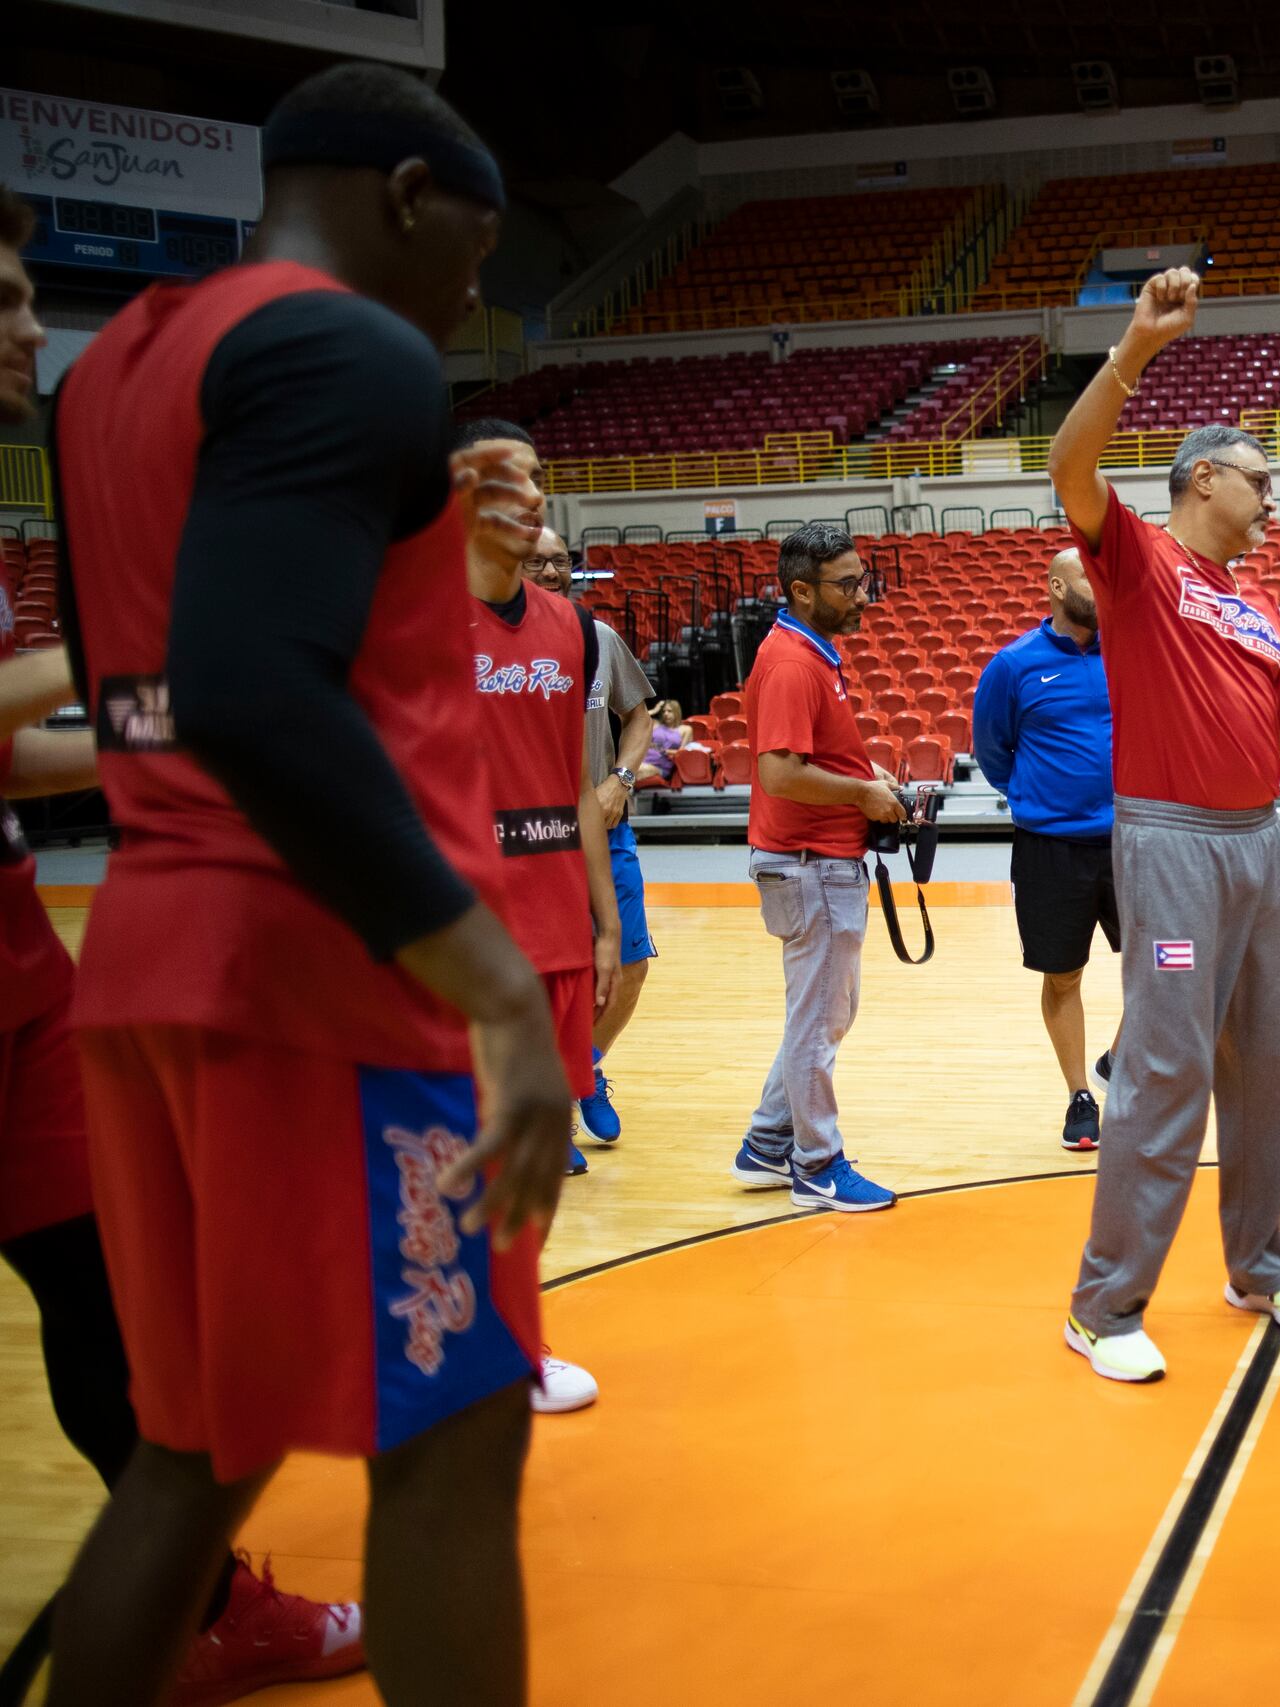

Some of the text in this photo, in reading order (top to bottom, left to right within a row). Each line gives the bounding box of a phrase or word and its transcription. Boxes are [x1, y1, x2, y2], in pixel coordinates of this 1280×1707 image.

[73, 244, 114, 258] PERIOD
[715, 517, 725, 532] F
[528, 659, 574, 701] Rico
